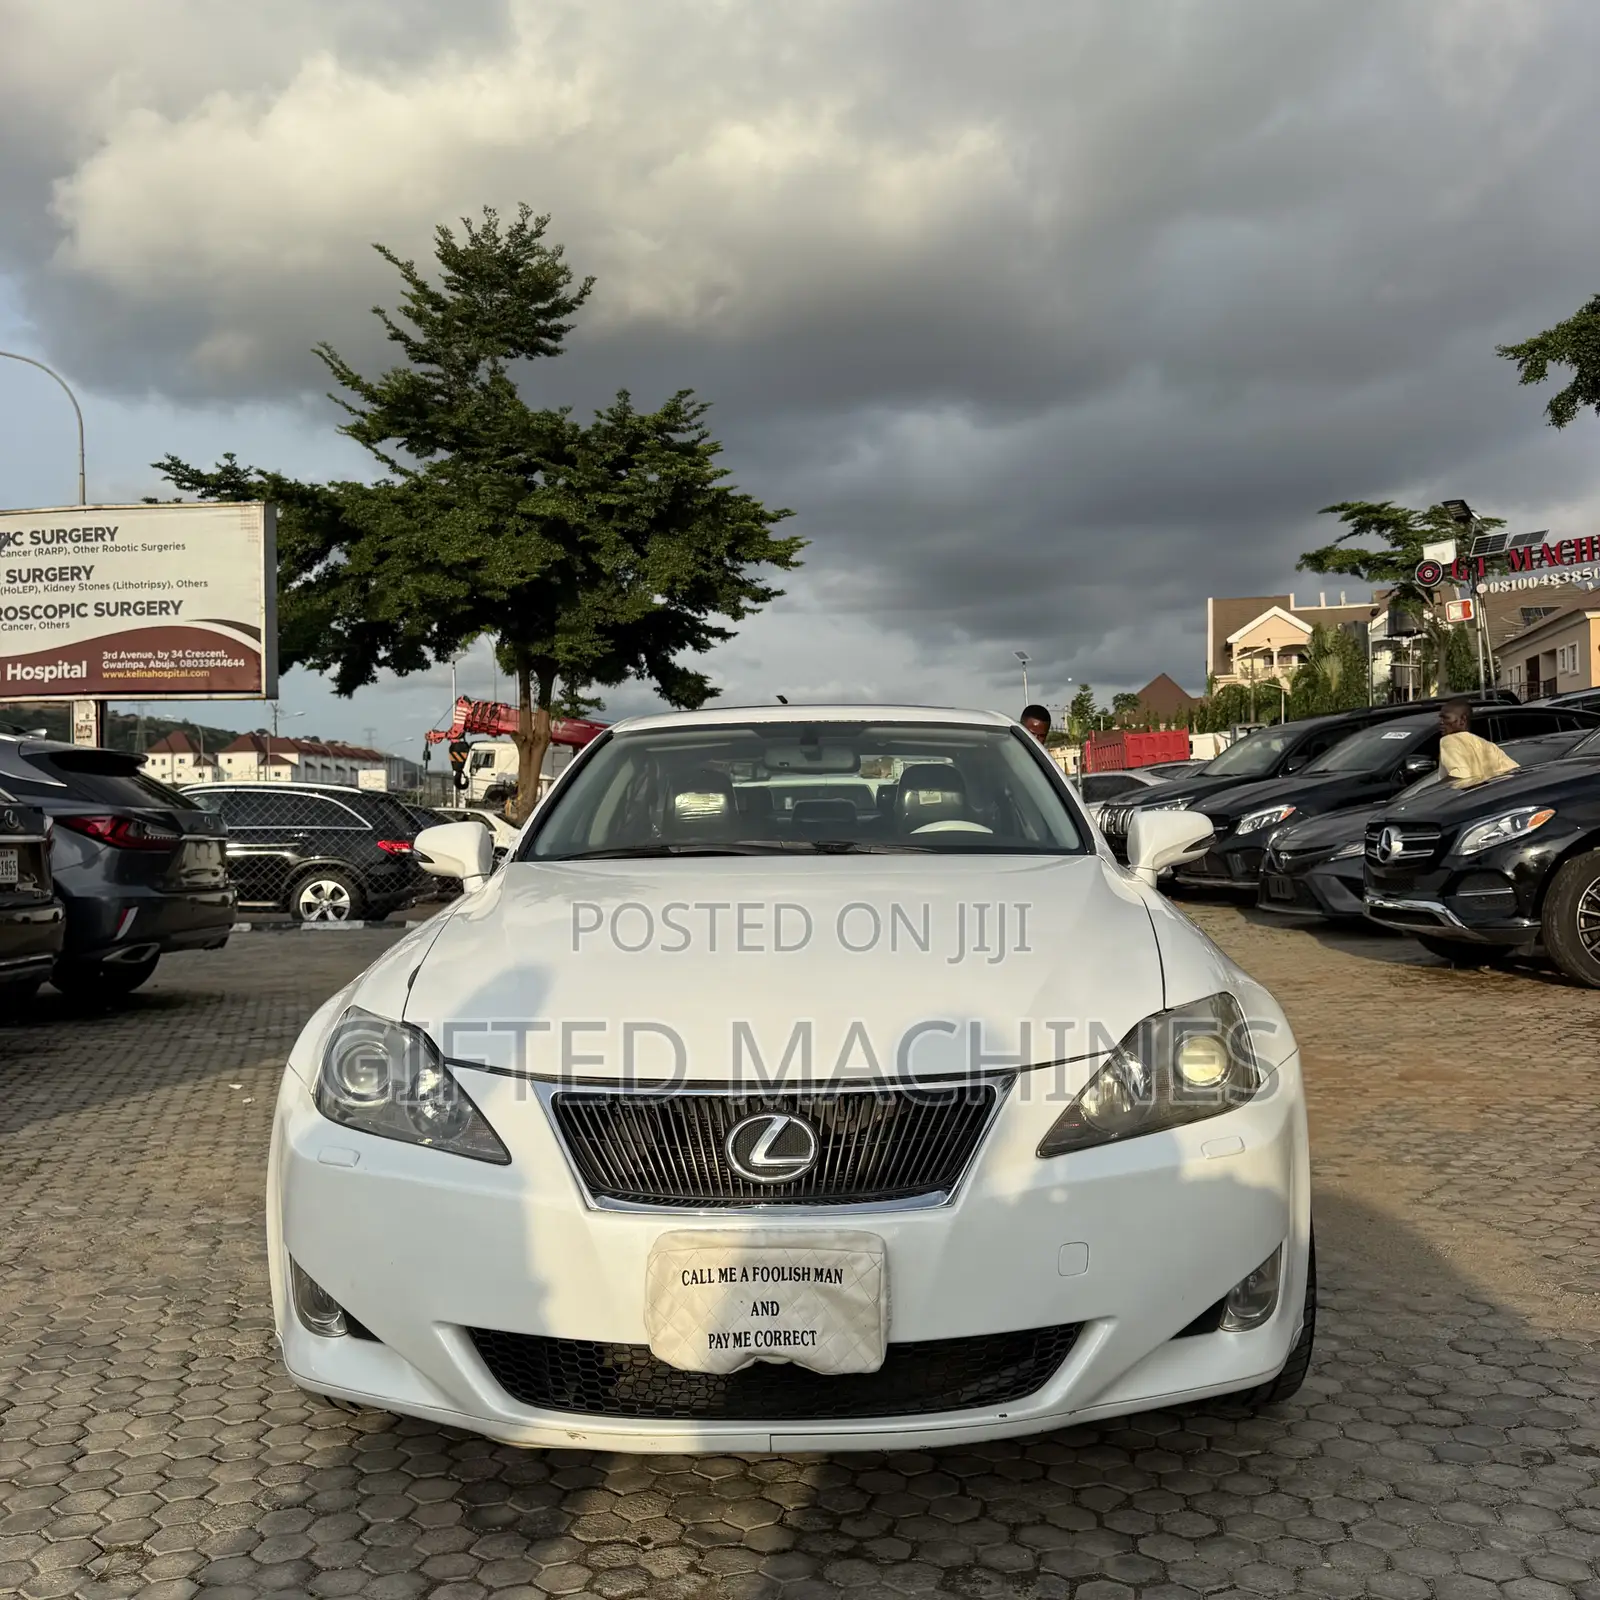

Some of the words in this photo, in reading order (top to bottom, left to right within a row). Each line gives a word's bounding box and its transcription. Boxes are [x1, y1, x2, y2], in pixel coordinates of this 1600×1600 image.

[0, 531, 24, 547] IC
[29, 526, 119, 546] SURGERY
[0, 548, 31, 558] Cancer
[34, 546, 71, 558] (RARP),
[73, 544, 99, 554] Other
[102, 543, 139, 553] Robotic
[141, 541, 186, 552] Surgeries
[6, 565, 95, 584] SURGERY
[1, 585, 41, 596] (HoLEP),
[43, 583, 76, 593] Kidney
[78, 582, 110, 592] Stones
[112, 580, 174, 592] (Lithotripsy),
[176, 579, 209, 589] Others
[0, 602, 88, 622] OSCOPIC
[94, 600, 184, 618] SURGERY
[1, 622, 36, 632] Cancer,
[39, 621, 70, 630] Others
[102, 651, 118, 660] 3rd
[120, 650, 156, 660] Avenue,
[157, 650, 169, 659] by
[171, 650, 183, 658] 34
[185, 649, 228, 659] Crescent,
[7, 660, 87, 683] Hospital
[102, 660, 147, 670] Gwarinpa,
[148, 659, 177, 670] Abuja.
[179, 658, 245, 668] 08033644644
[102, 669, 210, 679] www.kelinahospital.com
[681, 1267, 715, 1286] CALL
[718, 1267, 737, 1284] ME
[740, 1266, 749, 1283] A
[752, 1266, 811, 1283] FOOLISH
[813, 1268, 844, 1285] MAN
[750, 1300, 780, 1317] AND
[708, 1332, 730, 1350] PAY
[732, 1331, 752, 1349] ME
[754, 1330, 818, 1348] CORRECT
